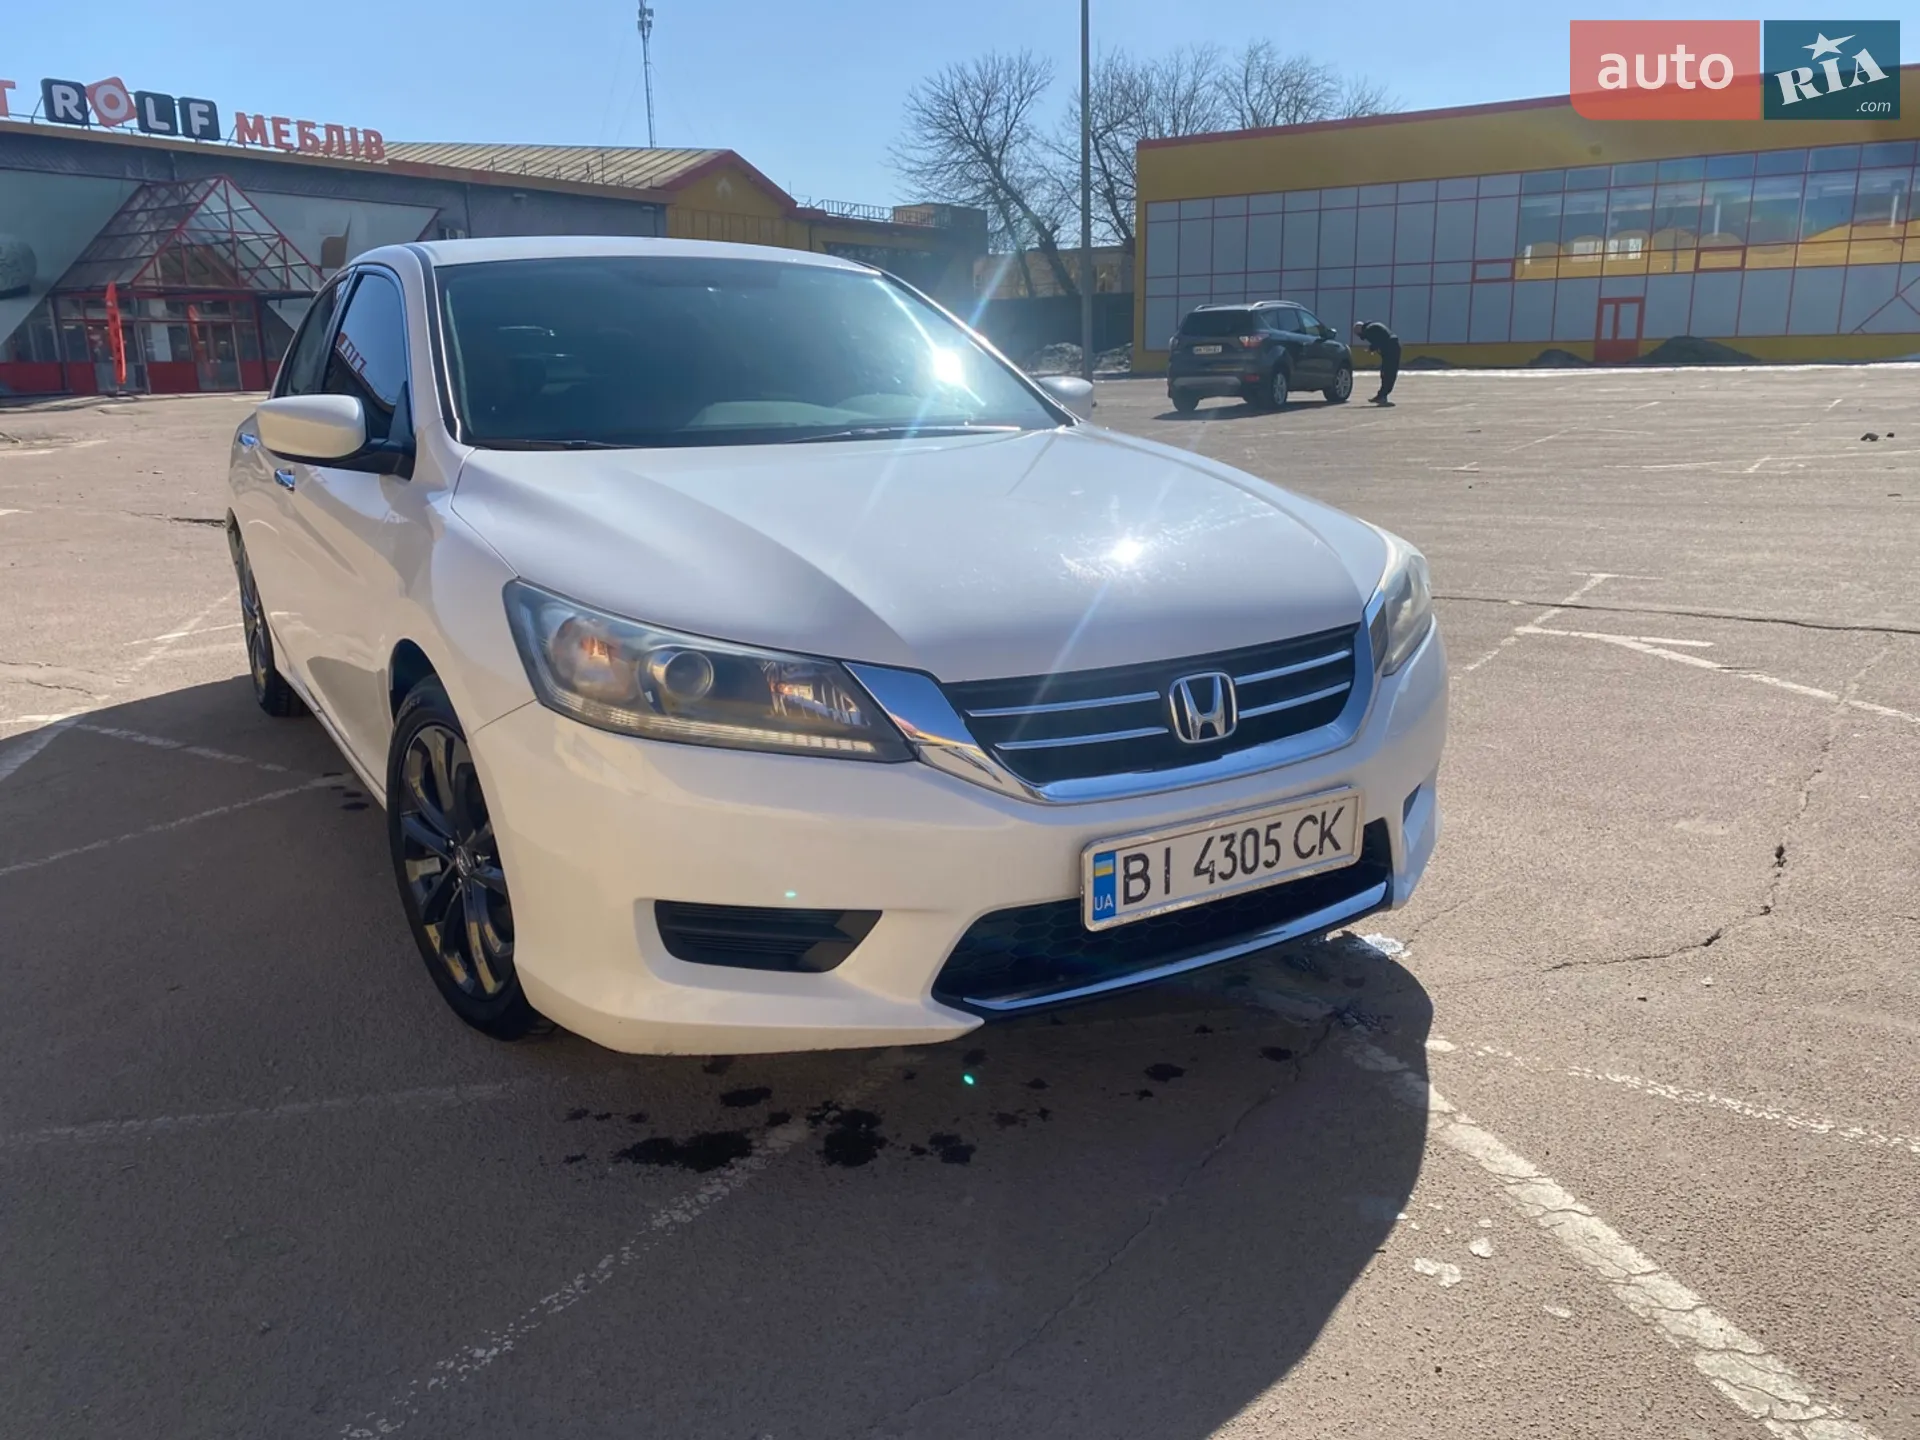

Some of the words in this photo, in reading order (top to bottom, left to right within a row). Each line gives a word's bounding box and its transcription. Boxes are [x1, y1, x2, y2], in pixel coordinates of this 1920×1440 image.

[51, 83, 211, 136] ROLF
[235, 112, 385, 160] МЕБЛІВ
[1122, 847, 1171, 906] BI
[1193, 821, 1282, 885] 4305
[1293, 806, 1345, 860] CK
[1094, 893, 1115, 911] UA
